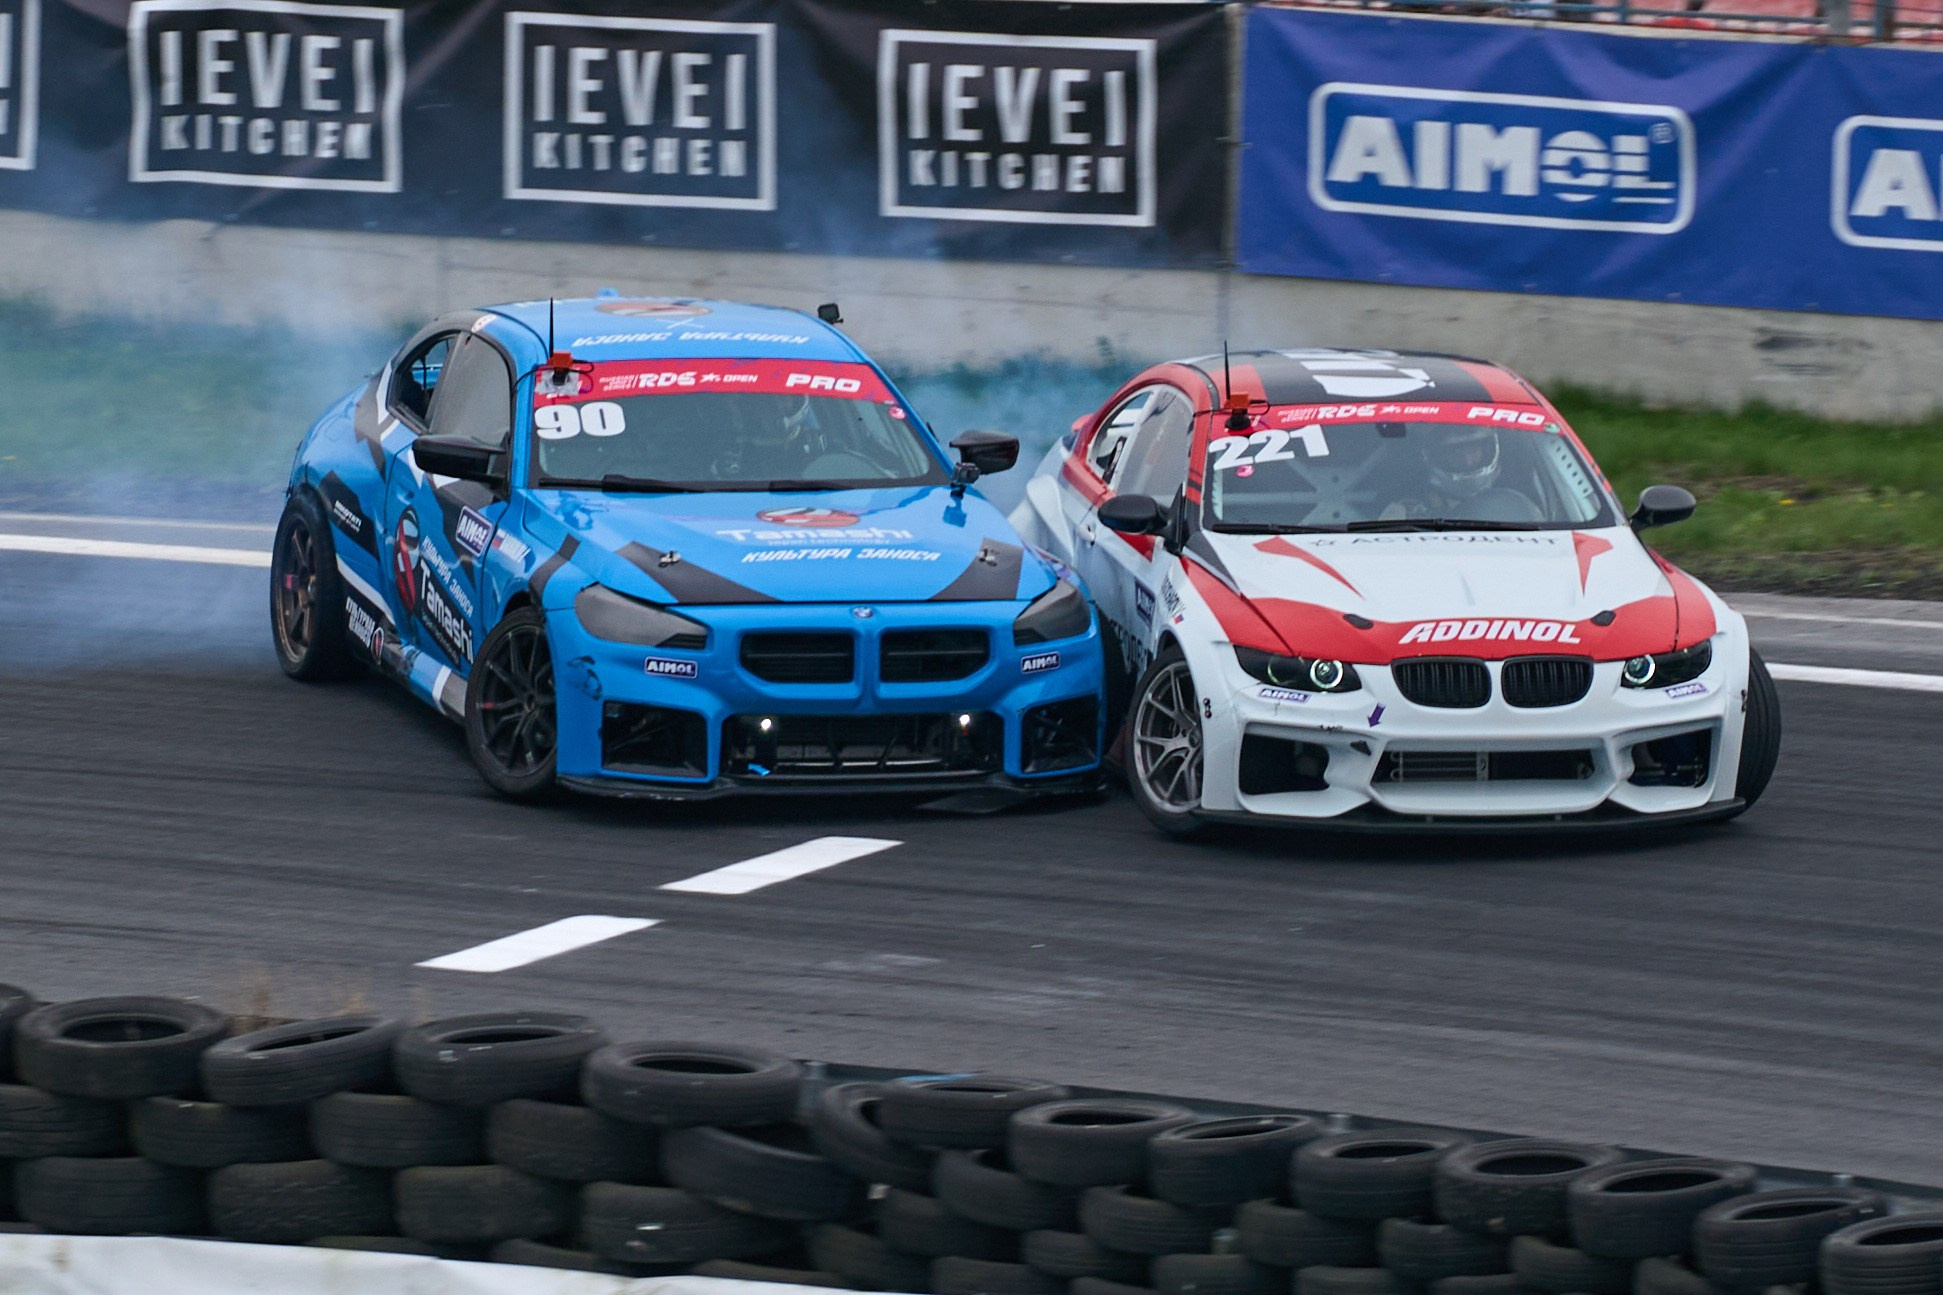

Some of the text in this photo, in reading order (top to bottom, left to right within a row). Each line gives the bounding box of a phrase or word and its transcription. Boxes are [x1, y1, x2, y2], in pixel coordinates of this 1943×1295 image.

[161, 113, 372, 159] KITCHEN
[533, 131, 746, 177] KITCHEN
[1326, 115, 1676, 204] AIMOL
[909, 150, 1125, 194] KITCHEN
[723, 374, 758, 383] OPEN
[785, 372, 862, 393] PRO
[534, 402, 626, 440] 90
[1404, 405, 1440, 414] OPEN
[1466, 406, 1546, 426] PRO
[1208, 424, 1330, 471] 221
[741, 548, 941, 563] КУЛЬТУРА ЗАНОСА
[420, 559, 474, 664] Tamashi
[1398, 619, 1582, 645] ADDINOL
[646, 659, 695, 676] AIMOL
[1021, 654, 1058, 671] AIMOL
[1260, 688, 1307, 701] AIMOL
